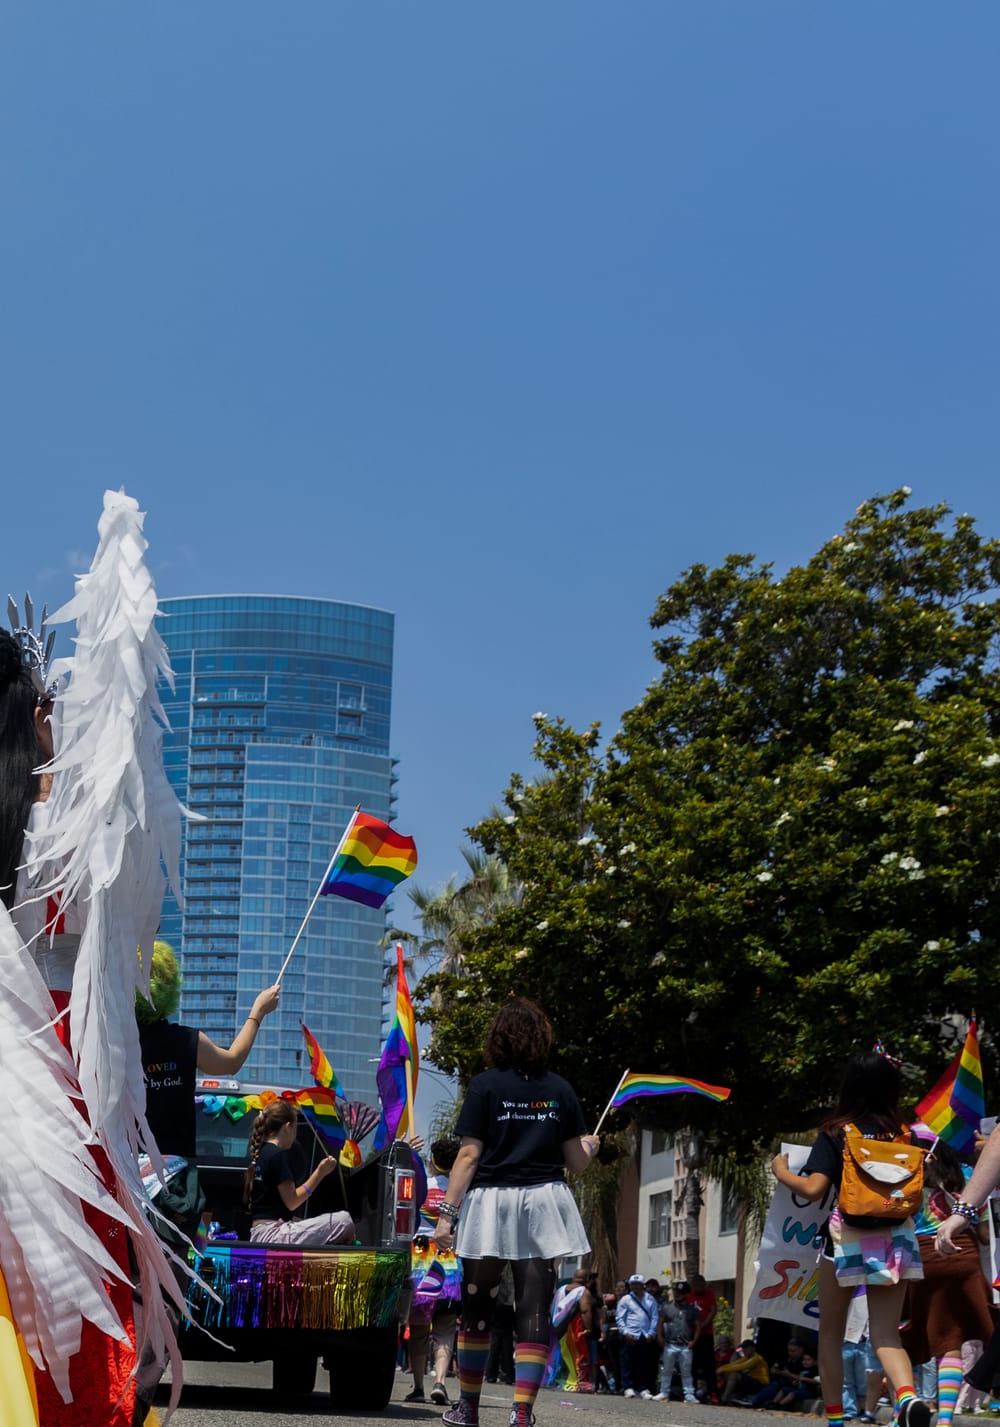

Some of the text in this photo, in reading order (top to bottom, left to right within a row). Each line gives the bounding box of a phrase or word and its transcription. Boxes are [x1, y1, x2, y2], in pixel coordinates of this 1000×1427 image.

[150, 1079, 162, 1090] by
[502, 1100, 516, 1109] You
[496, 1111, 510, 1121] and
[537, 1112, 547, 1121] by
